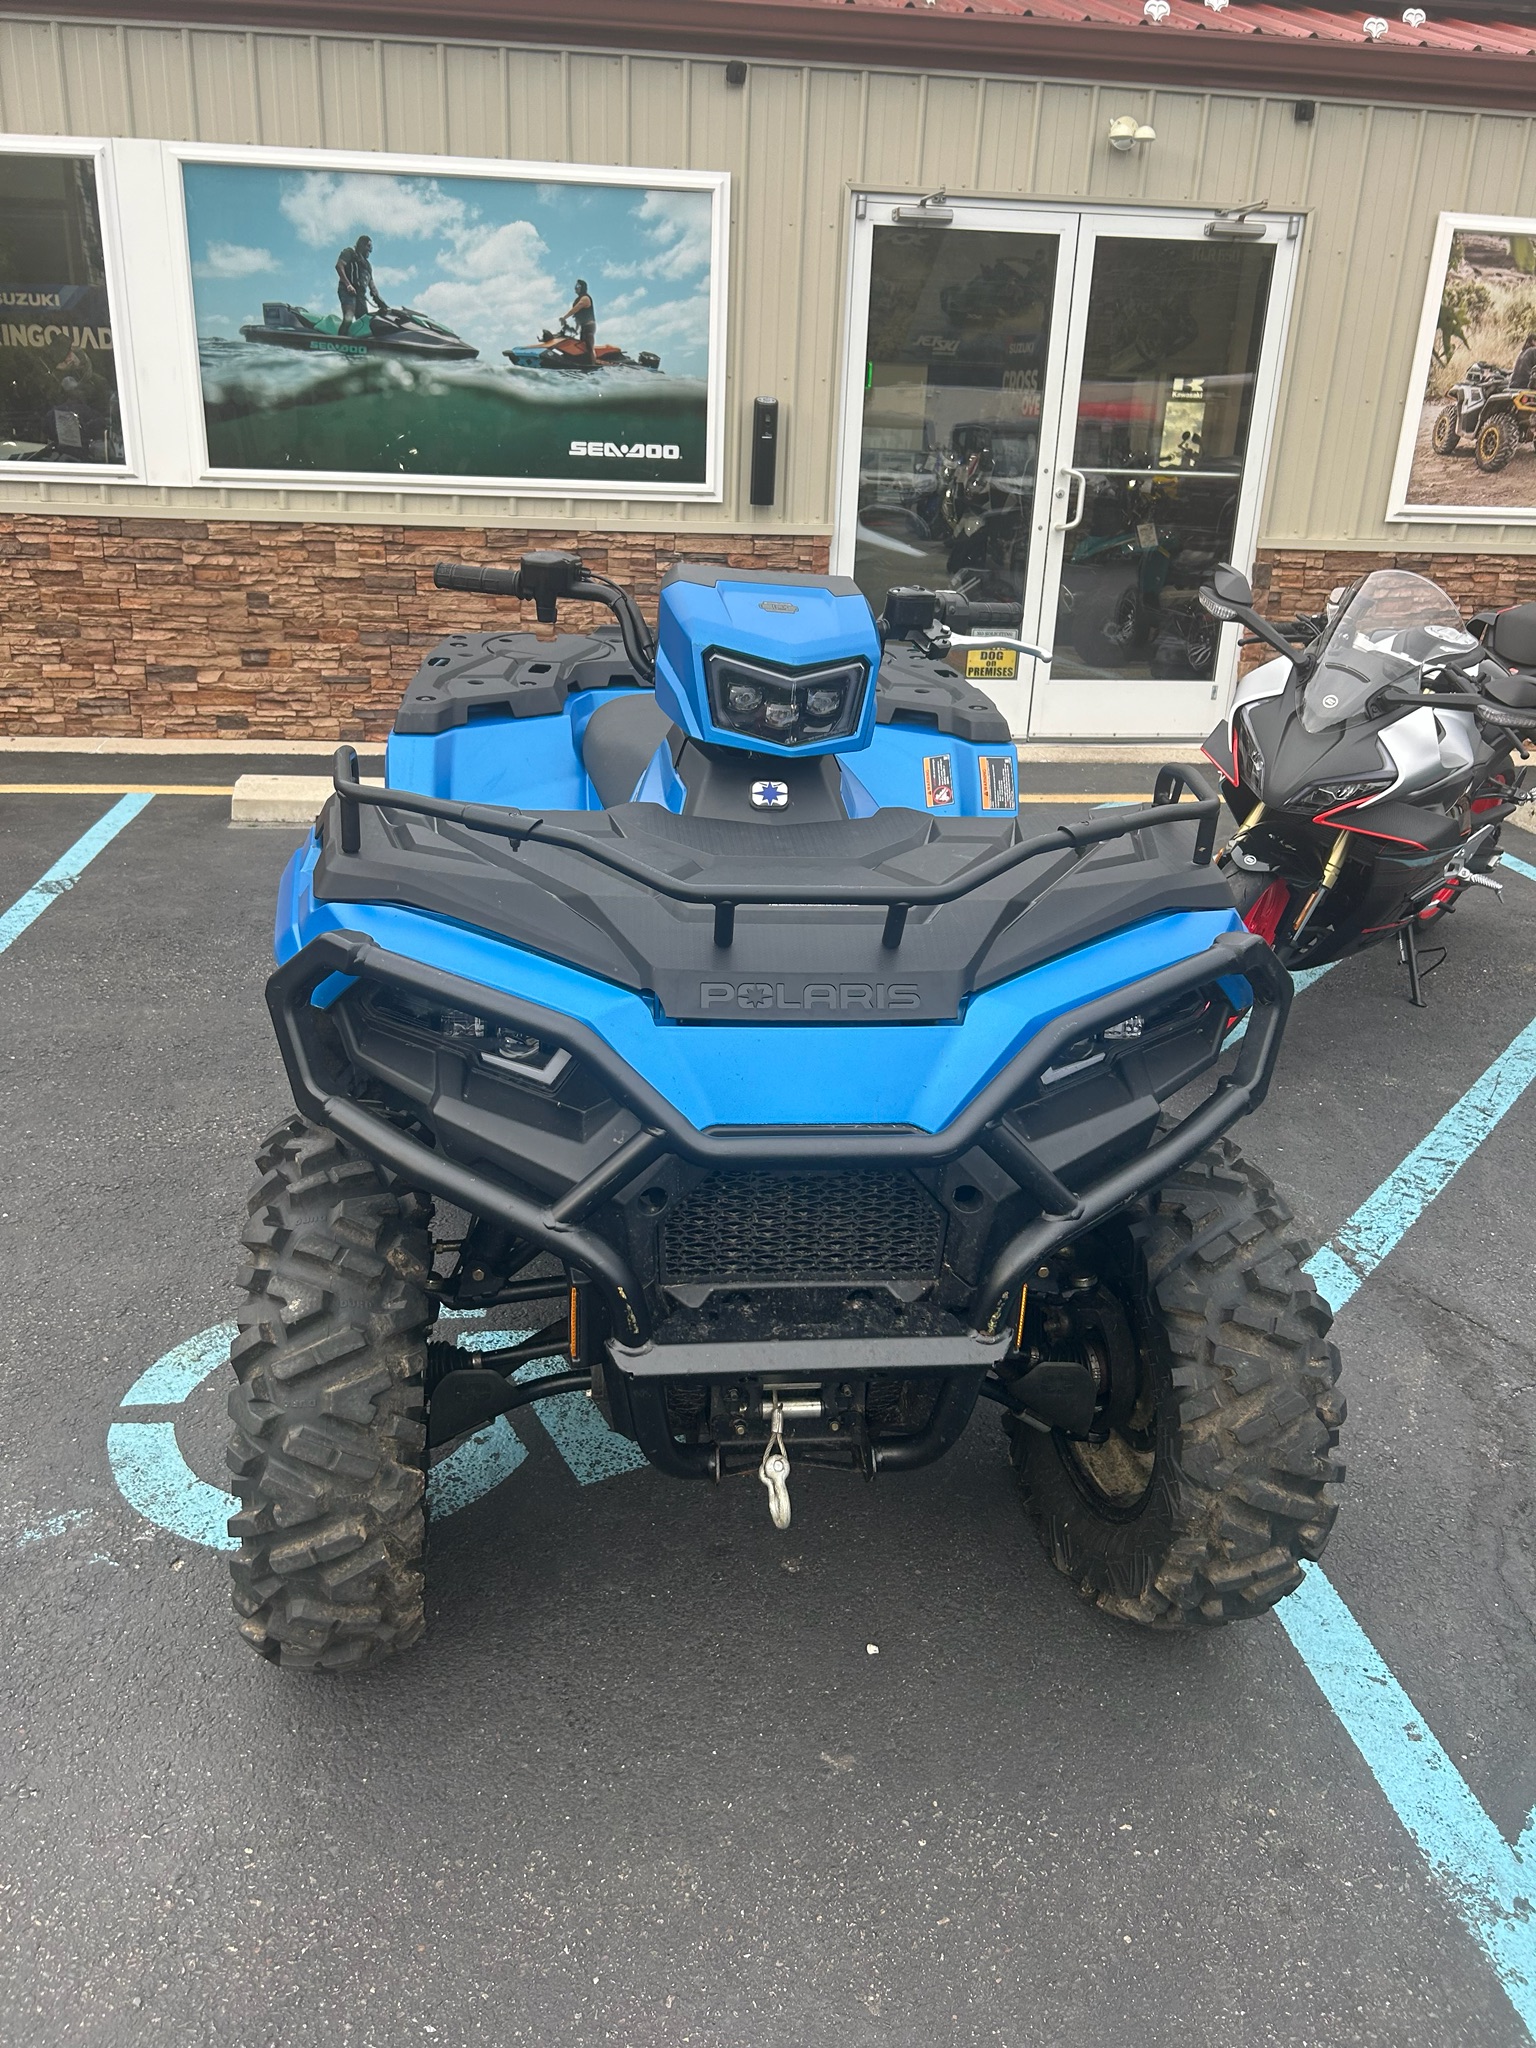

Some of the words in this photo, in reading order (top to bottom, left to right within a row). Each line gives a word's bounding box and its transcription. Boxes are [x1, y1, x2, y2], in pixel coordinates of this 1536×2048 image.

[0, 323, 113, 350] INGQUAD
[980, 651, 1004, 661] DOG
[967, 667, 1014, 677] PREMISES
[700, 981, 921, 1010] POLARIS
